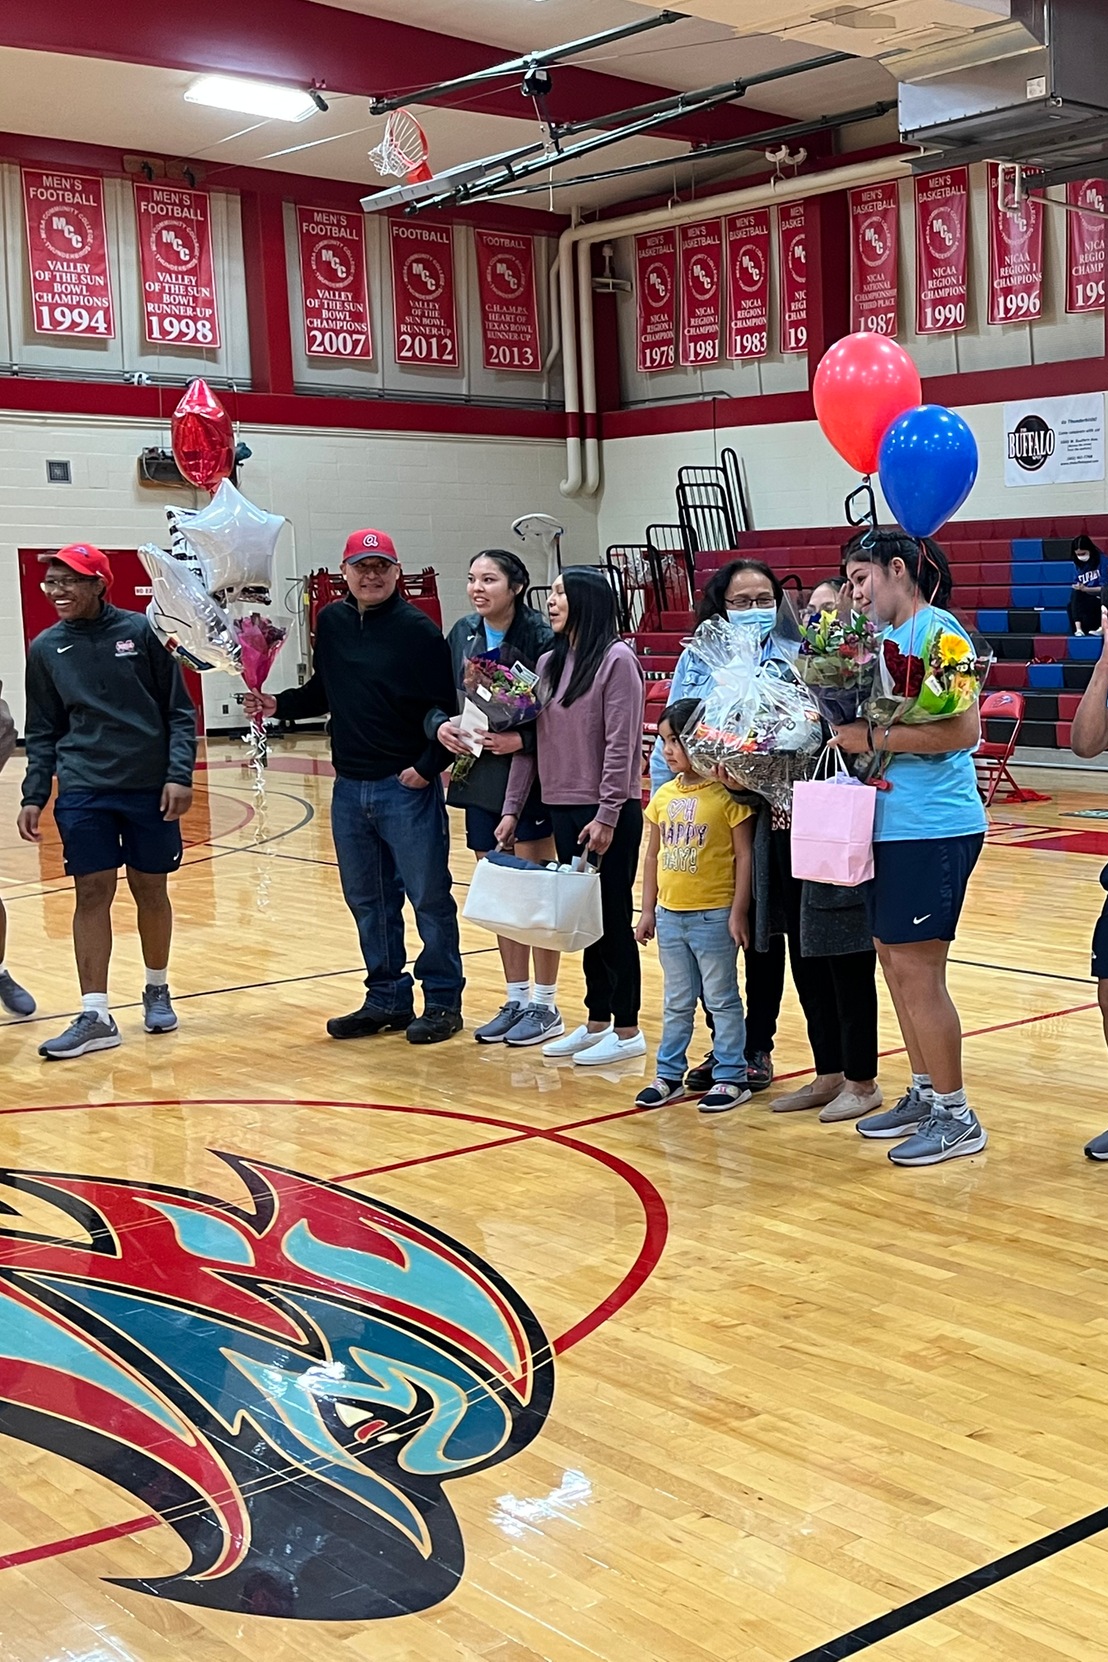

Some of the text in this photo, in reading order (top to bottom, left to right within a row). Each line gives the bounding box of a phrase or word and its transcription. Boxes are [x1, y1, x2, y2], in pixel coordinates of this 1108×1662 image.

[43, 176, 82, 190] MEN'S
[929, 176, 952, 188] MEN'S
[30, 188, 97, 206] FOOTBALL
[154, 190, 190, 205] MEN'S
[861, 189, 882, 202] MEN'S
[918, 185, 966, 203] BASKETBALL
[141, 202, 204, 220] FOOTBALL
[853, 198, 896, 216] BASKETBALL
[314, 212, 347, 225] MEN'S
[736, 216, 755, 227] MEN'S
[53, 217, 82, 248] MCC
[303, 223, 358, 240] FOOTBALL
[393, 226, 449, 243] FOOTBALL
[687, 226, 706, 237] MEN'S
[730, 225, 768, 240] BASKETBALL
[162, 230, 189, 261] MCC
[483, 236, 526, 249] FOOTBALL
[682, 235, 720, 250] BASKETBALL
[639, 244, 674, 258] BASKETBALL
[47, 260, 90, 273] VALLEY
[1005, 254, 1030, 266] NJCAA
[36, 270, 104, 286] OF THE SUN
[158, 272, 197, 285] VALLEY
[932, 266, 957, 278] NJCAA
[1000, 265, 1030, 278] REGION
[928, 276, 957, 289] REGION
[994, 272, 1042, 289] CHAMPIONS
[54, 283, 90, 295] BOWL
[146, 282, 210, 297] OF THE SUN
[317, 289, 352, 301] VALLEY
[36, 292, 109, 307] CHAMPIONS
[162, 294, 195, 306] BOWL
[306, 299, 364, 312] OF THE SUN
[410, 300, 440, 310] VALLEY
[741, 299, 761, 308] NJCAA
[997, 291, 1040, 318] 1996
[147, 303, 212, 318] RUNNER-UP
[322, 310, 352, 321] BOWL
[425, 309, 440, 318] THE
[489, 313, 512, 322] HEART
[696, 306, 714, 316] NJCAA
[924, 302, 965, 328] 1990
[39, 306, 108, 334] 1994
[307, 318, 367, 331] CHAMPIONS
[405, 316, 446, 327] SUN BOWL
[485, 321, 533, 333] TEXAS BOWL
[858, 313, 895, 334] 1987
[149, 316, 213, 342] 1998
[400, 324, 451, 336] RUNNER-UP
[487, 330, 531, 342] RUNNER-UP
[310, 331, 366, 355] 2007
[399, 335, 454, 360] 2012
[688, 339, 718, 361] 1981
[734, 332, 767, 354] 1983
[489, 345, 534, 366] 2013
[645, 345, 674, 367] 1978
[1008, 430, 1054, 458] BUFFALO
